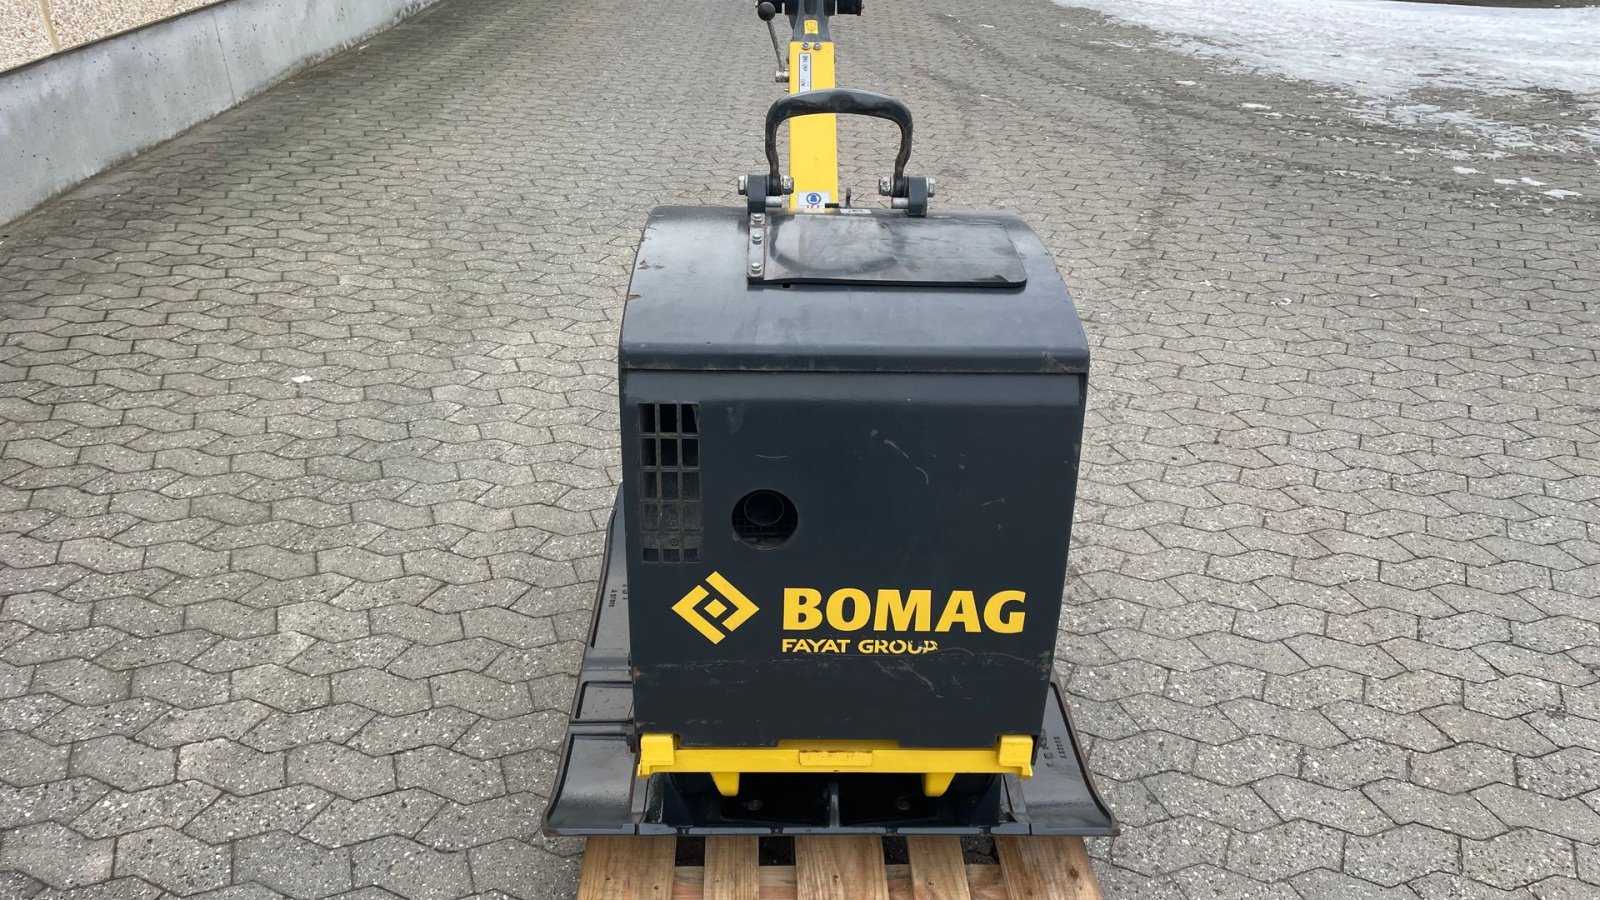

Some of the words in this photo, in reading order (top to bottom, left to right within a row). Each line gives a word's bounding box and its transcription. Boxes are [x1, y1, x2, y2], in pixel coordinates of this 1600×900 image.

[782, 587, 1026, 634] BOMAG
[781, 638, 851, 654] FAYAT
[857, 639, 938, 655] GROUP
